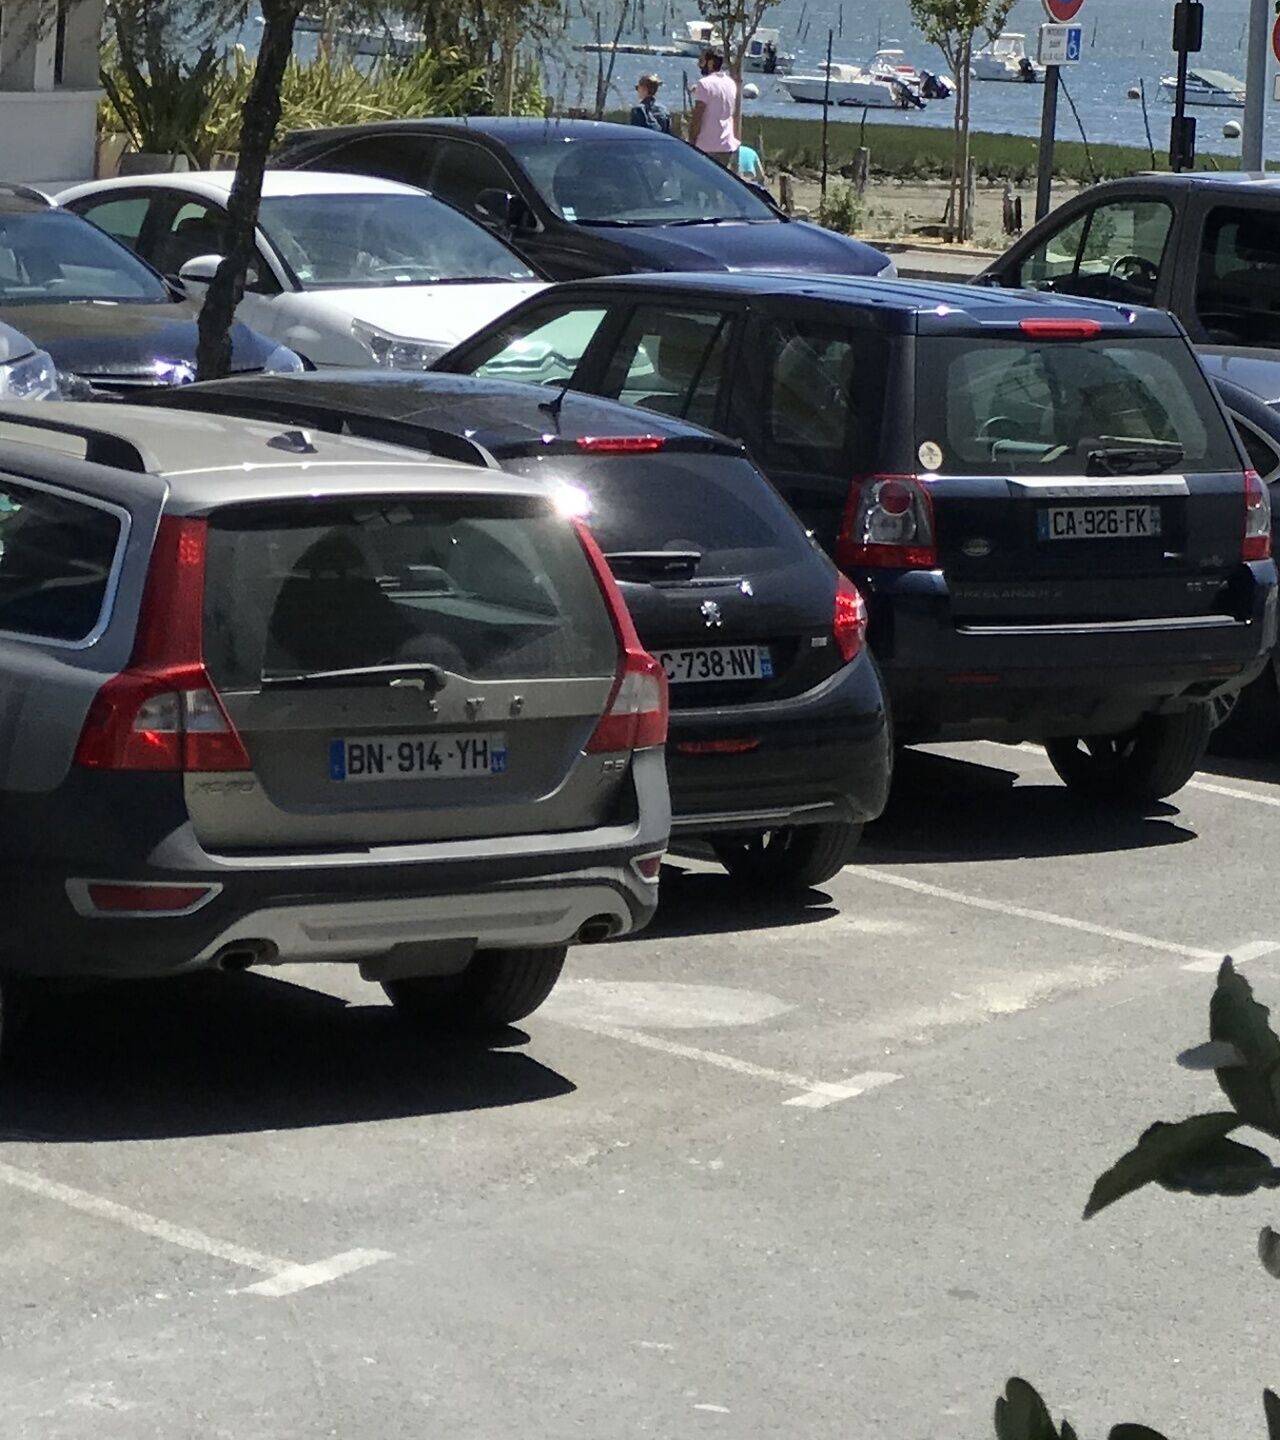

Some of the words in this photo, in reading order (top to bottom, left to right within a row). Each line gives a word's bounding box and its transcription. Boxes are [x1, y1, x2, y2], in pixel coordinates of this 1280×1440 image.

[1053, 509, 1148, 536] CA-926-FK
[658, 648, 757, 680] C-738-NV
[348, 738, 488, 775] BN-914-YH
